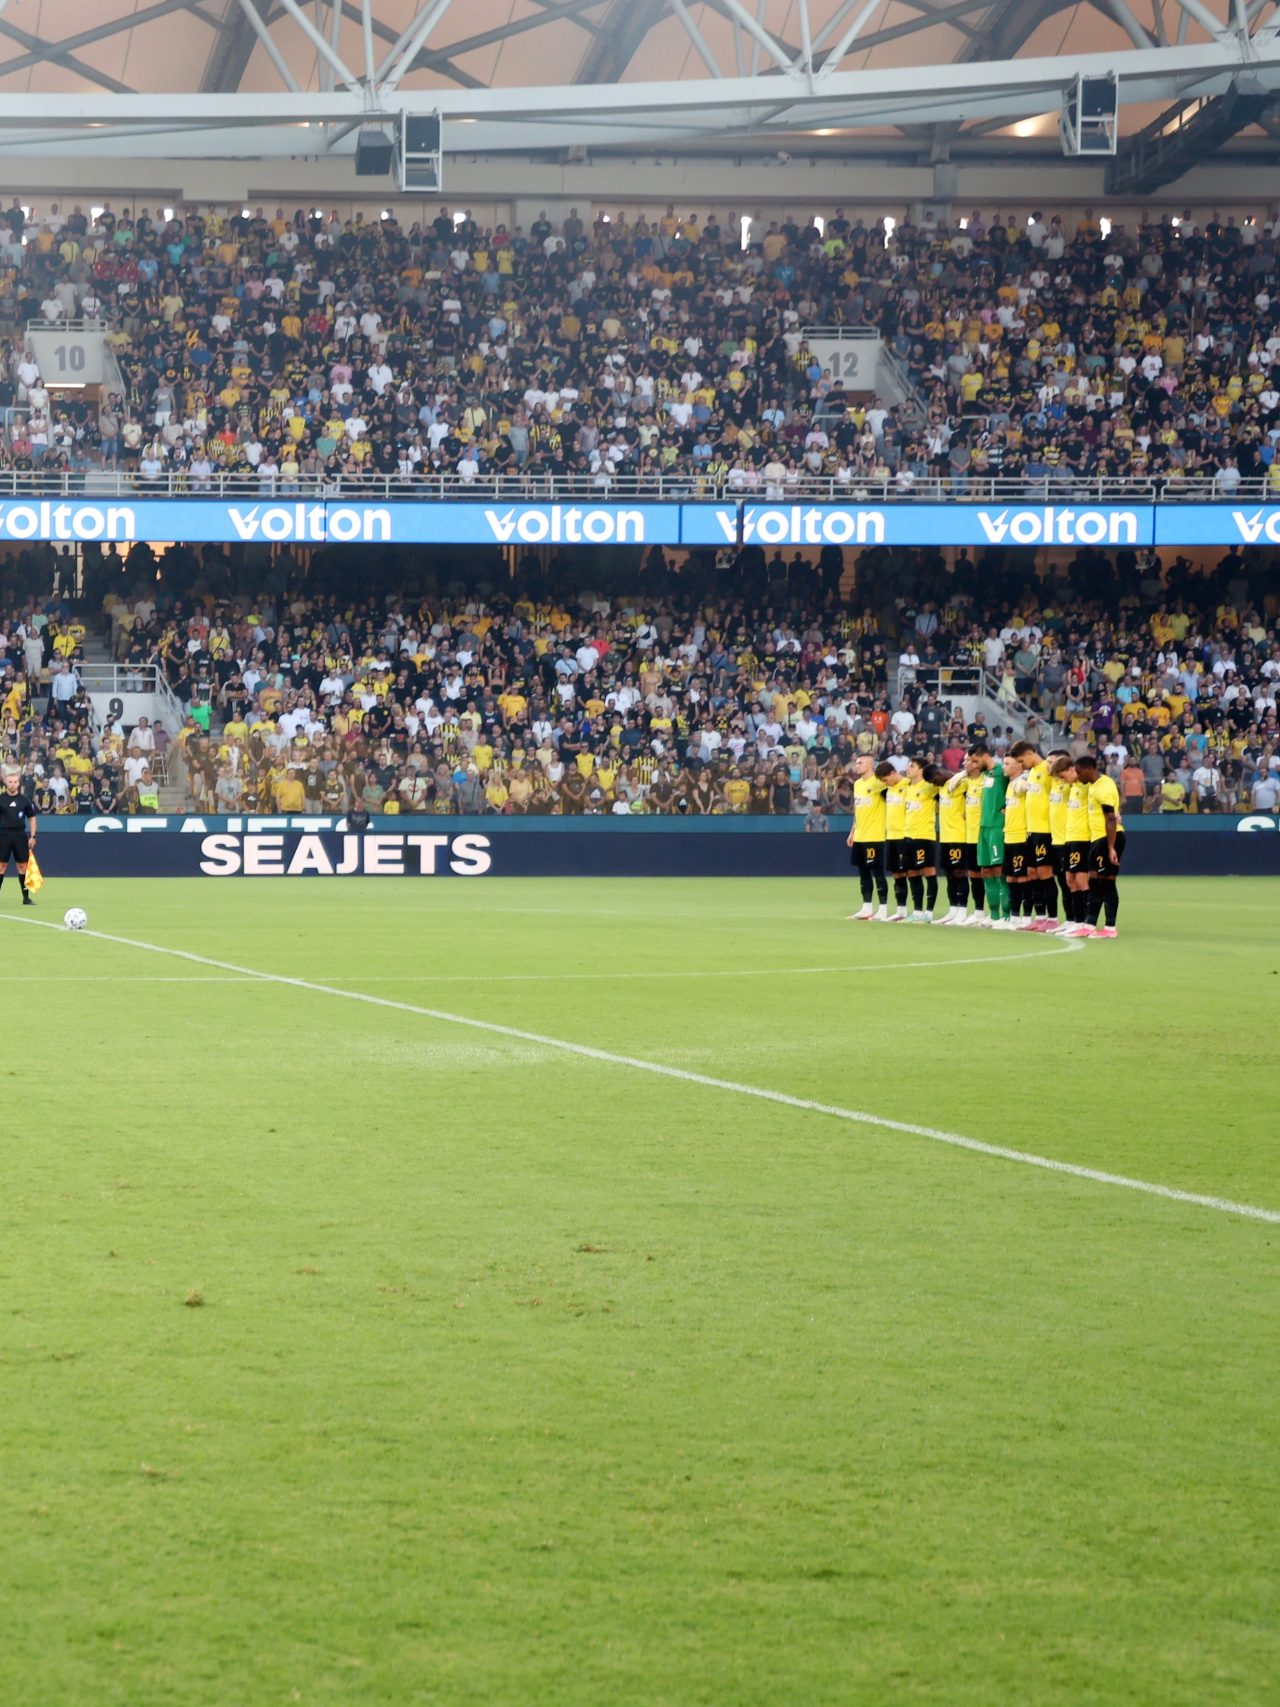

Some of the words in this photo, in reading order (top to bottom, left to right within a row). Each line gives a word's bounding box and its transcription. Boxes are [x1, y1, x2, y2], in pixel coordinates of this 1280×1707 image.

[53, 345, 86, 372] 10
[828, 351, 859, 377] 12
[228, 504, 392, 541] volton
[485, 506, 645, 543] volton
[716, 506, 885, 544] volton
[978, 507, 1137, 544] volton
[109, 698, 124, 720] 9
[199, 834, 492, 876] SEAJETS
[866, 848, 876, 859] 10
[916, 849, 925, 860] 12
[949, 848, 962, 860] 90
[992, 845, 998, 857] 1
[1069, 851, 1081, 864] 29
